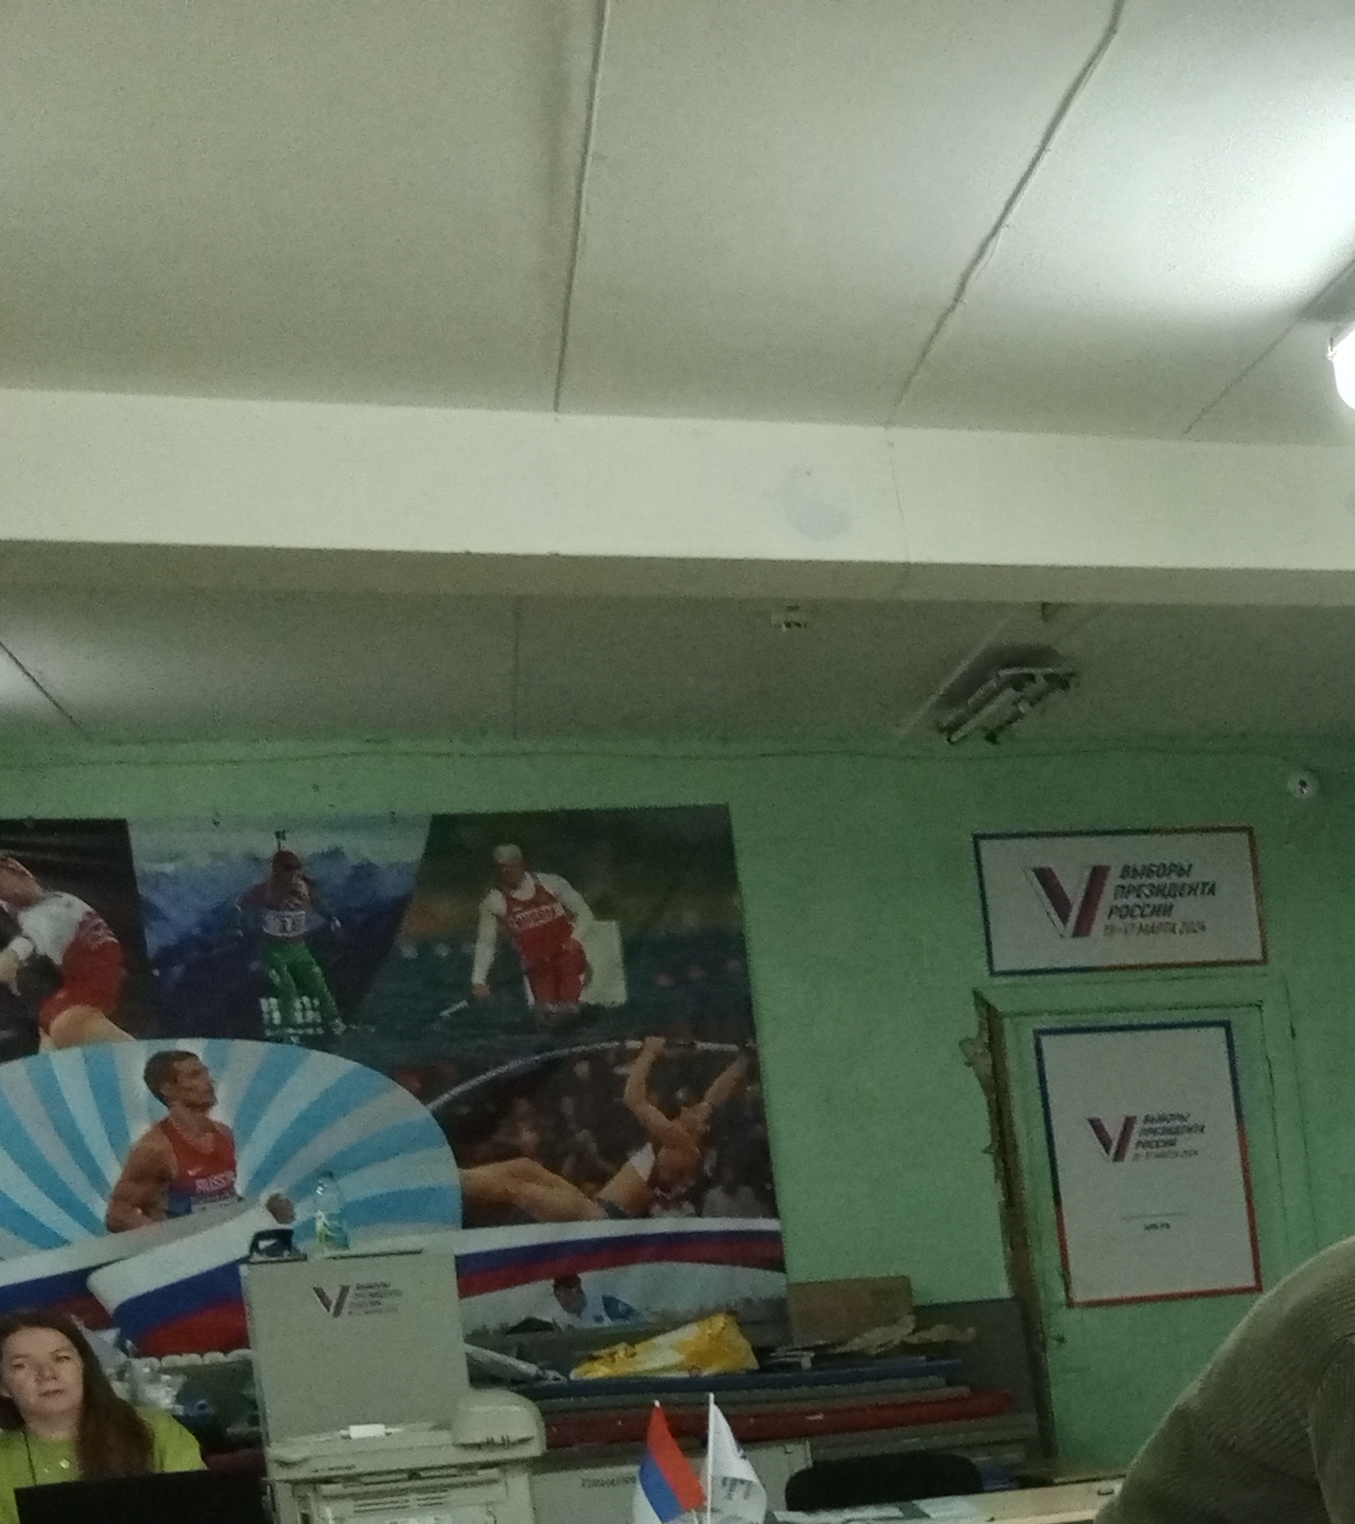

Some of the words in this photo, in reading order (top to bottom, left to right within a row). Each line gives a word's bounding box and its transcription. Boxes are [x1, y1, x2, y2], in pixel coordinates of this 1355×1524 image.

[1119, 862, 1193, 880] ВЫБОРЫ
[1113, 881, 1217, 900] ПРЕЗИДЕНТА
[1107, 902, 1175, 920] РОССИИ
